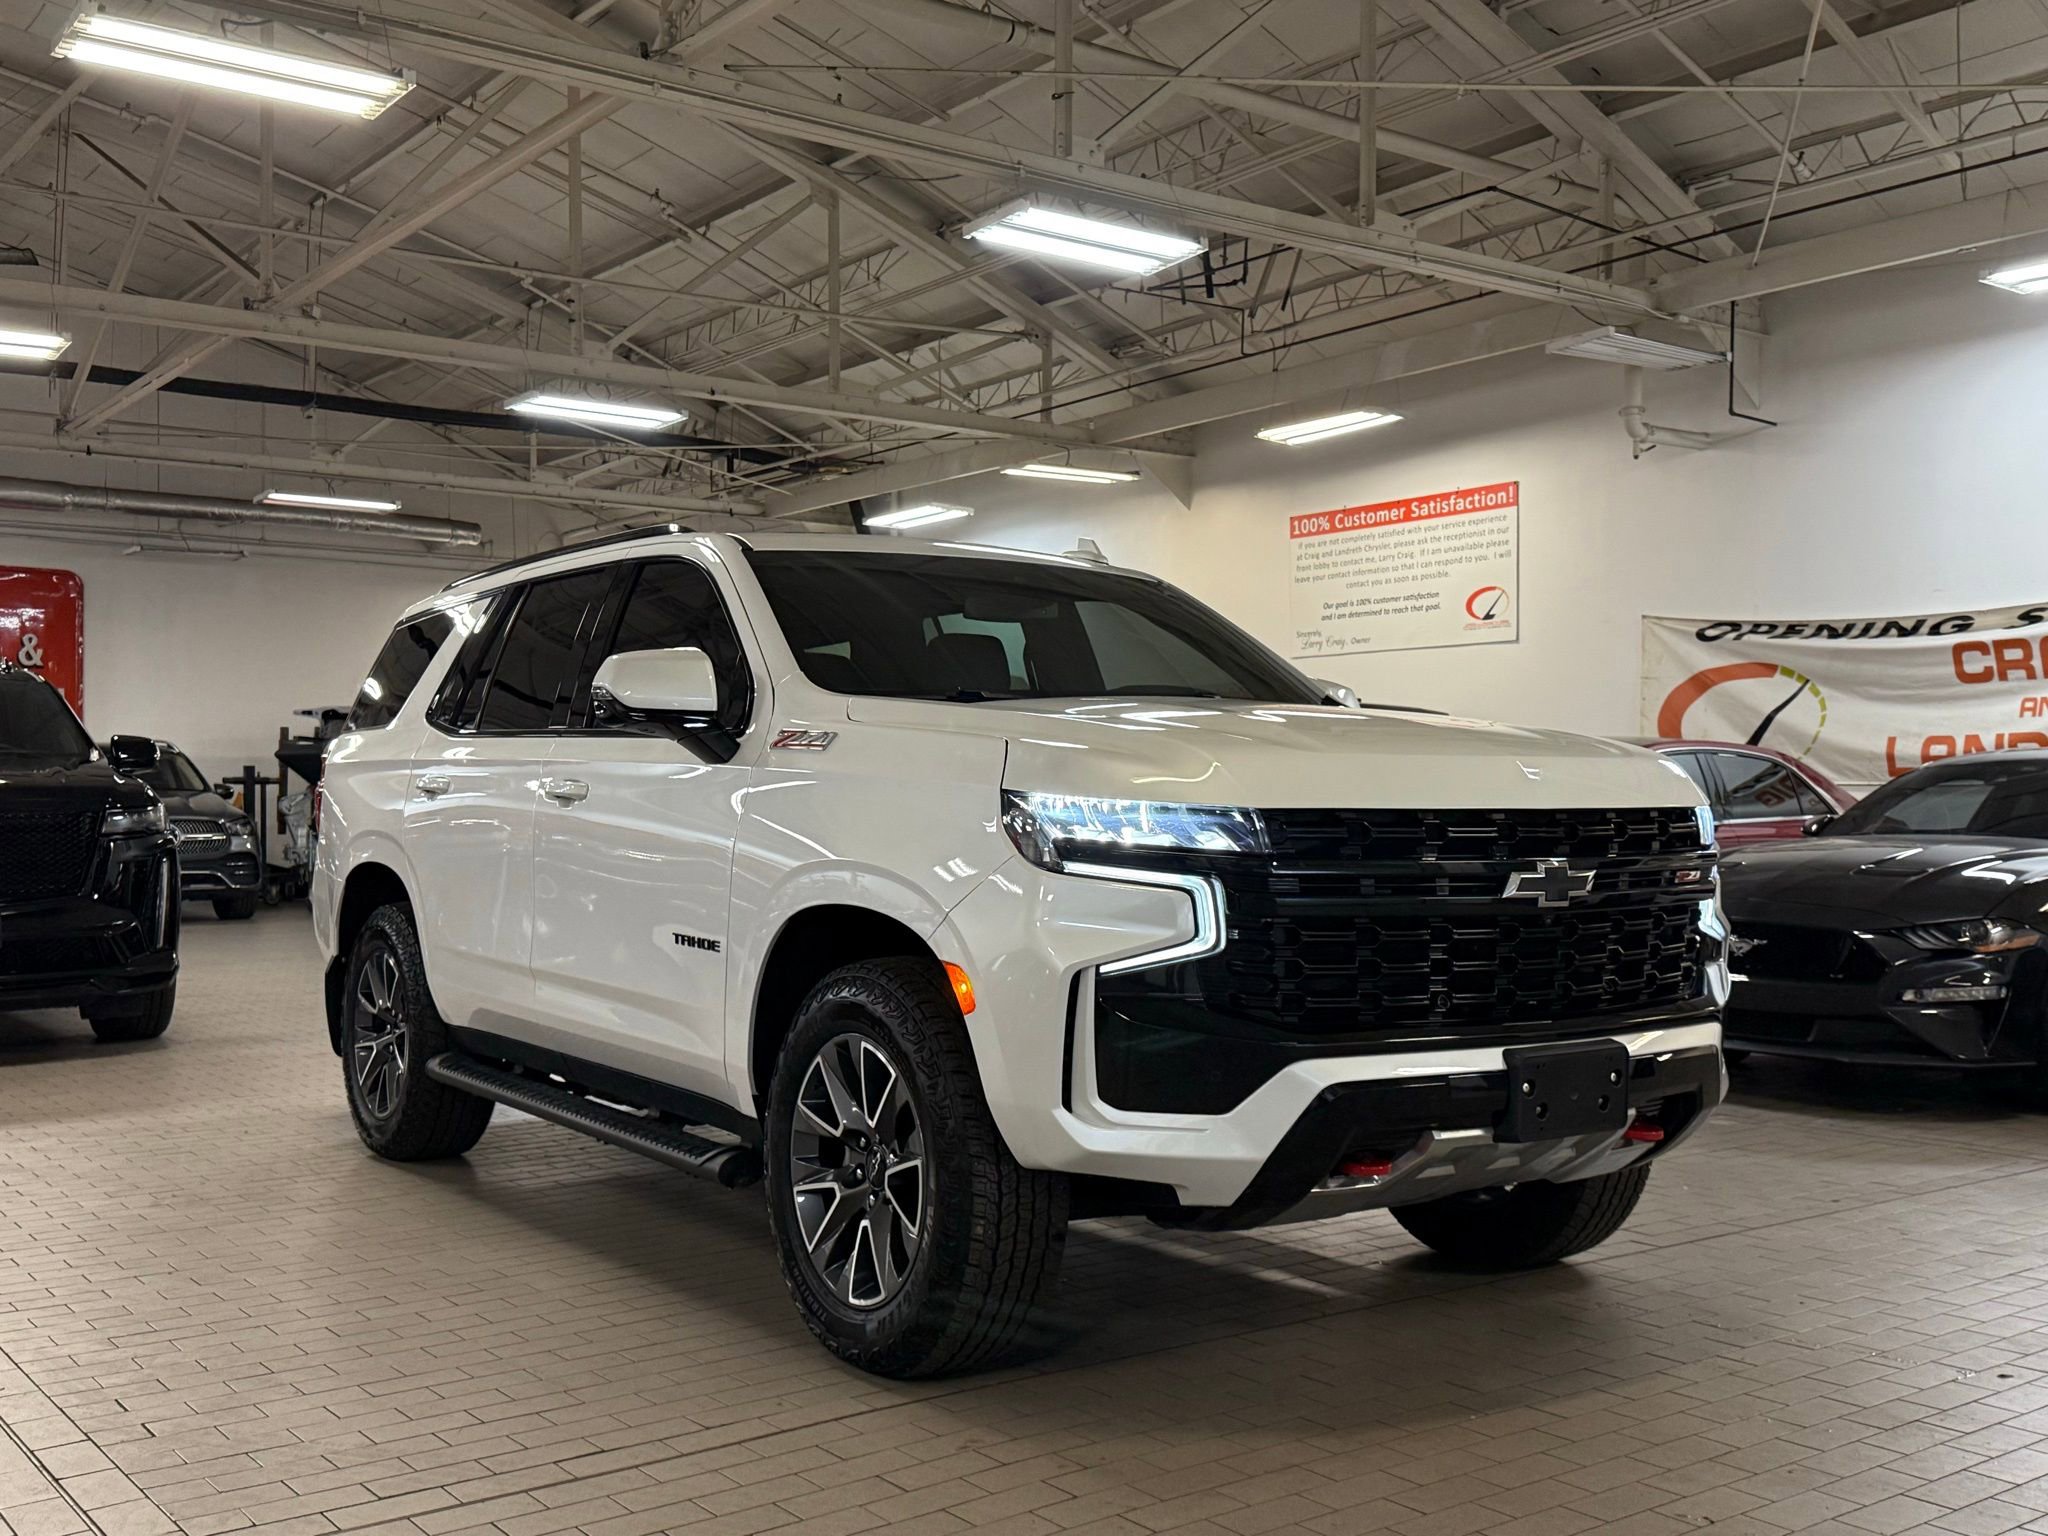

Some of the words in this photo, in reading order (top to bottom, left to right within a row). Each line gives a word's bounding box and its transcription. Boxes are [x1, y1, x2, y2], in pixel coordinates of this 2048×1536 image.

[1293, 516, 1330, 535] 100%
[1335, 507, 1406, 529] Customer
[1411, 486, 1514, 517] Satisfaction!
[1341, 532, 1376, 544] completely
[1378, 528, 1405, 538] satisfied
[1407, 526, 1422, 535] with
[1424, 525, 1440, 534] your
[1442, 520, 1466, 530] service
[1468, 514, 1507, 526] experience
[1296, 564, 1311, 572] front
[1314, 562, 1330, 570] lobby
[1340, 558, 1364, 567] contact
[1378, 554, 1396, 563] Larry
[1420, 548, 1426, 556] If
[1444, 542, 1484, 554] unavailable
[1486, 539, 1510, 550] please
[1304, 552, 1320, 561] Craig
[1322, 550, 1333, 558] and
[1335, 546, 1362, 556] Landreth
[1394, 540, 1415, 550] please
[1418, 538, 1428, 546] ask
[1444, 530, 1486, 542] receptionist
[1294, 576, 1310, 584] leave
[1312, 574, 1326, 582] your
[1328, 570, 1350, 580] contact
[1352, 566, 1390, 577] information
[1401, 562, 1414, 570] that
[1434, 555, 1462, 567] respond
[1474, 554, 1490, 562] you.
[1498, 550, 1512, 558] will
[1346, 580, 1370, 589] contact
[1371, 578, 1383, 587] you
[1394, 576, 1410, 584] soon
[1420, 570, 1450, 582] possible.
[1321, 613, 1332, 621] and
[1348, 608, 1382, 619] determined
[1392, 606, 1408, 614] reach
[1425, 602, 1440, 613] goal.
[1323, 602, 1334, 610] Our
[1335, 600, 1348, 610] goal
[1373, 596, 1401, 604] customer
[1402, 592, 1440, 602] satisfaction
[1350, 637, 1371, 645] Owner
[1695, 615, 1975, 642] OPENING
[18, 633, 44, 667] &
[1952, 636, 2048, 685] CR
[672, 932, 721, 953] TAHOE
